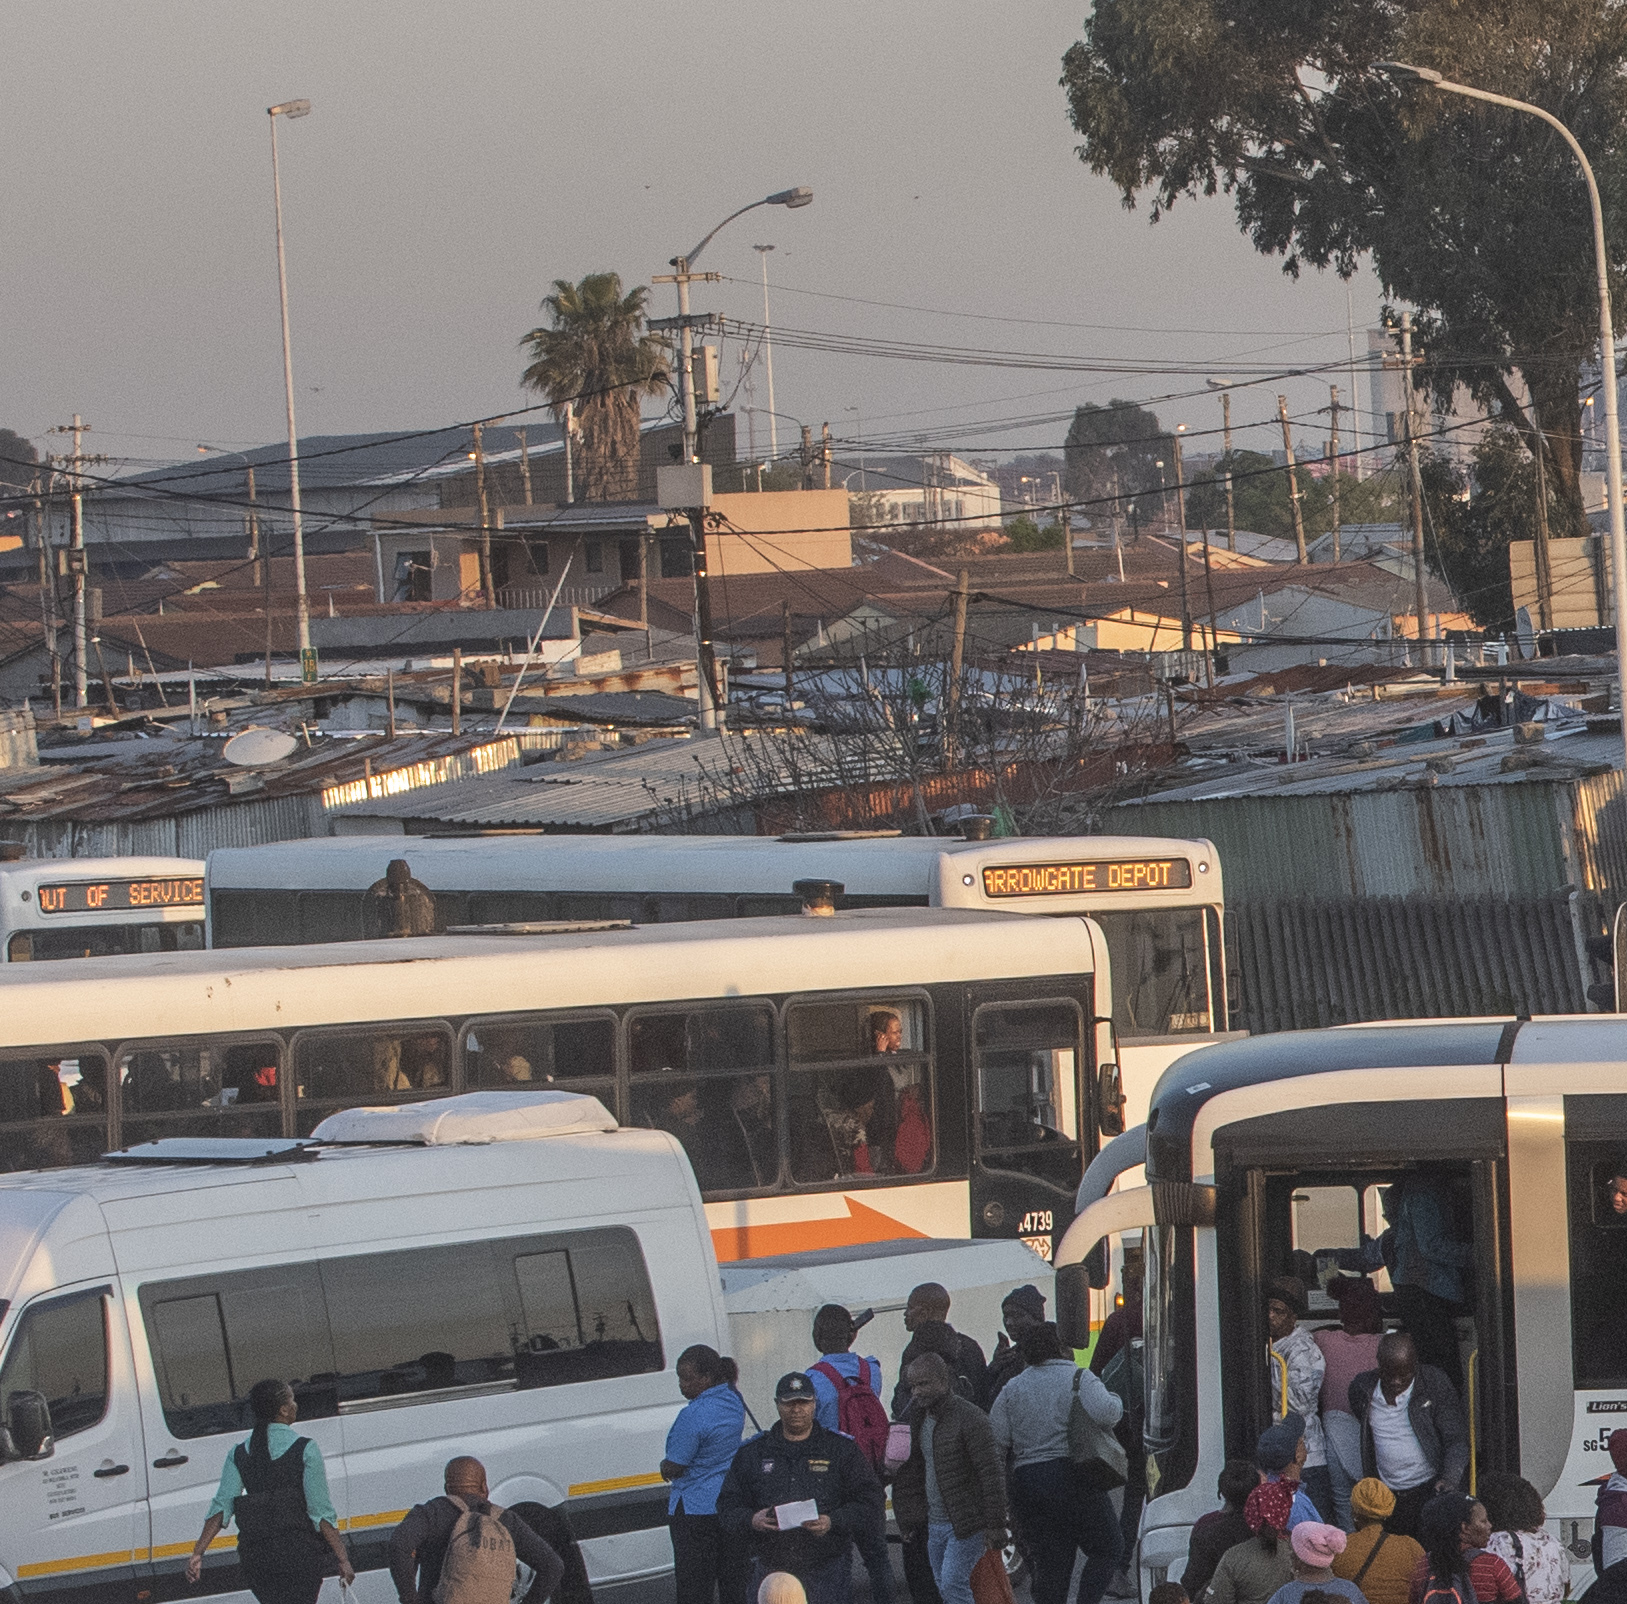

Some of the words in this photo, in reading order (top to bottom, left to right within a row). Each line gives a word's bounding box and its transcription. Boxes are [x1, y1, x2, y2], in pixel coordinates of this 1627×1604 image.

[985, 866, 1097, 892] ARROWGATE
[1108, 863, 1172, 888] DEPOT
[87, 885, 110, 907] OF
[129, 880, 203, 905] SERVICE
[1591, 1401, 1627, 1411] Lion's
